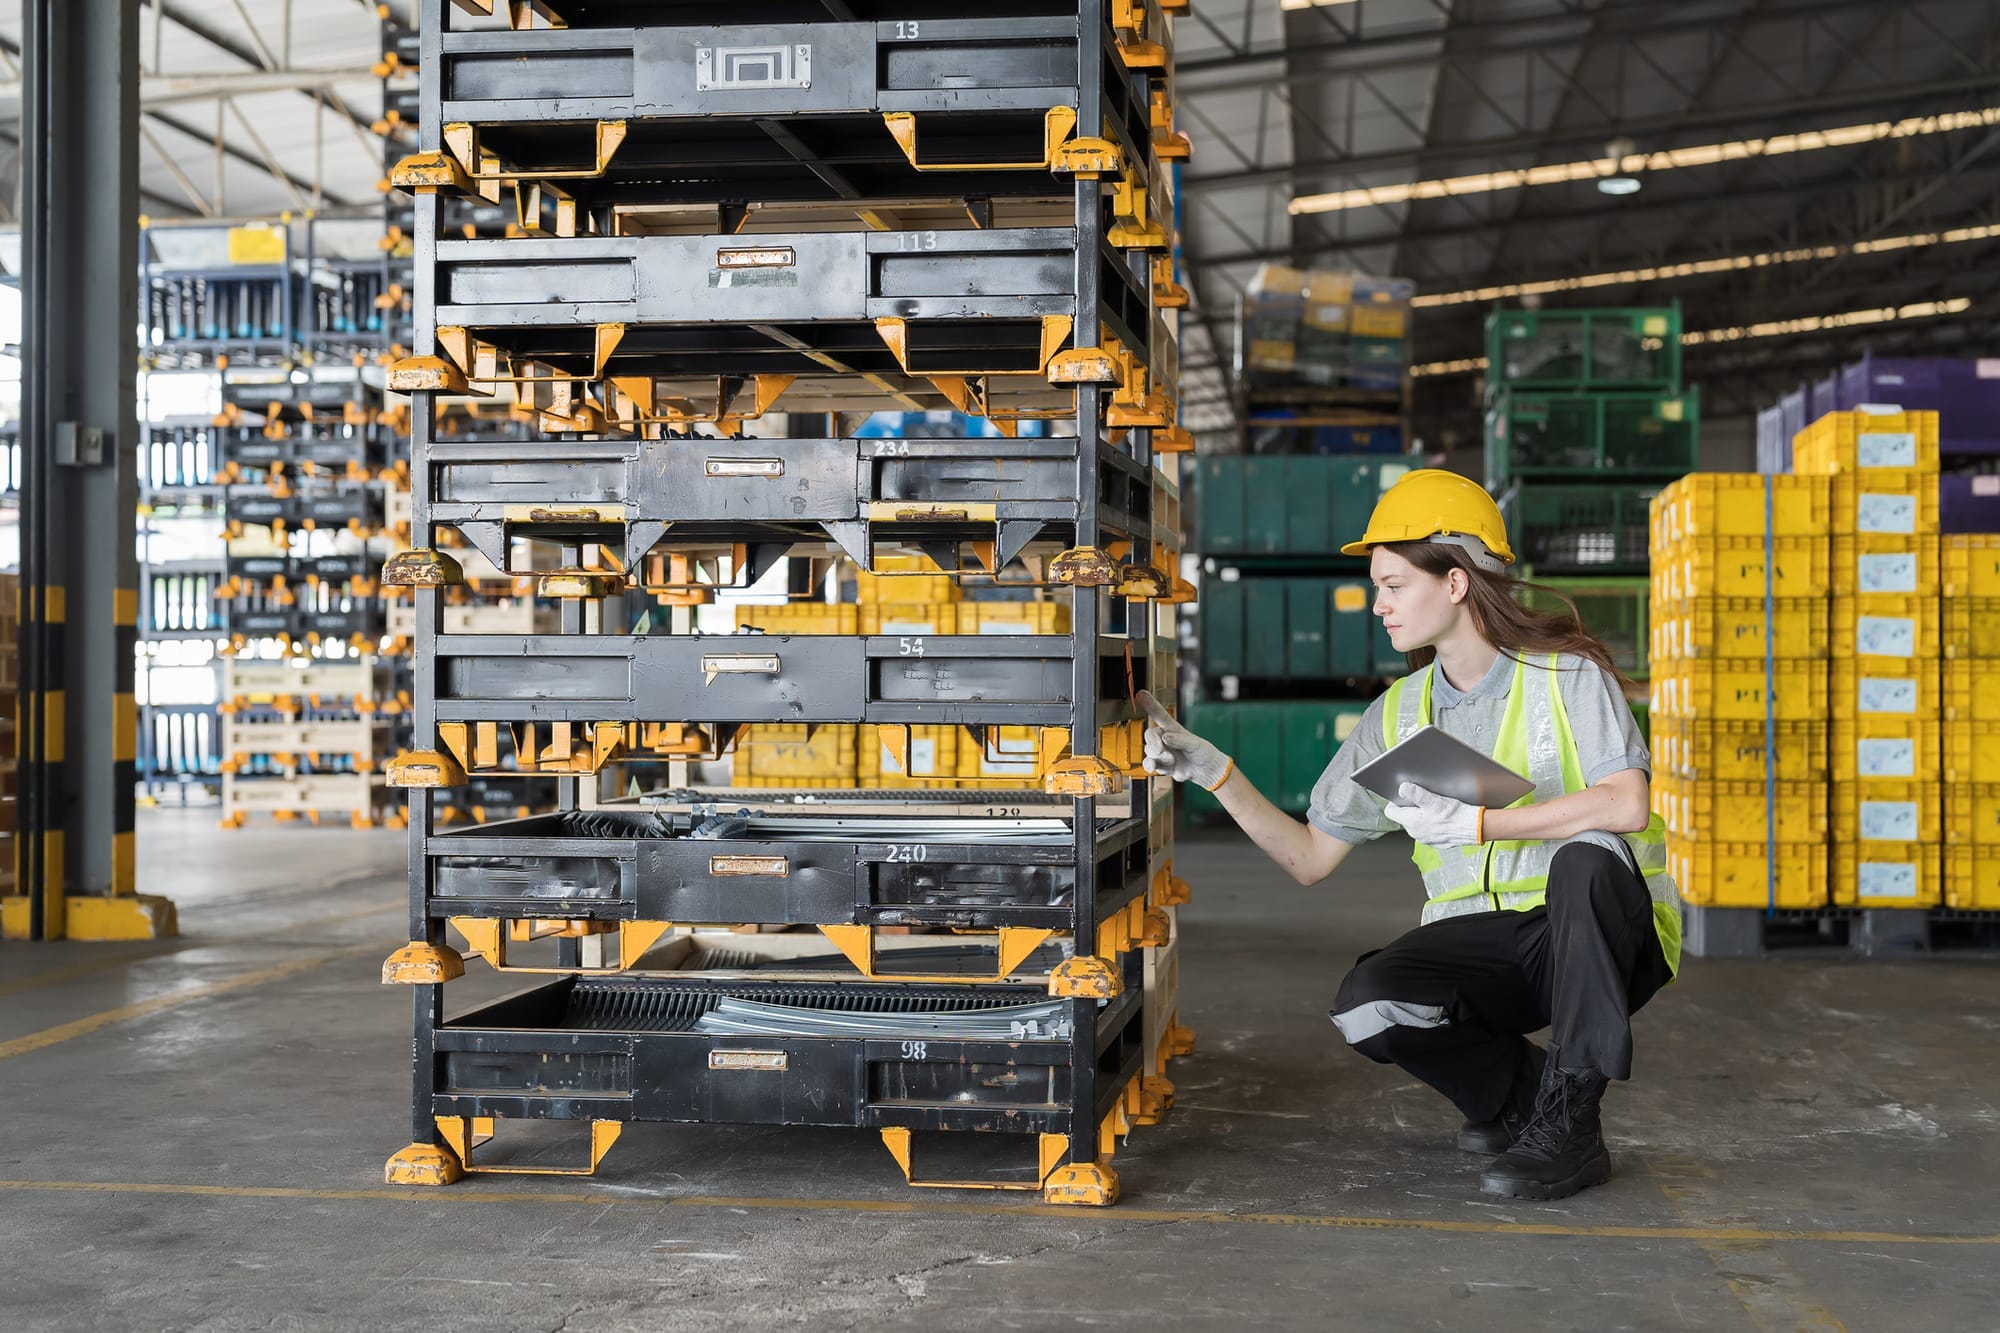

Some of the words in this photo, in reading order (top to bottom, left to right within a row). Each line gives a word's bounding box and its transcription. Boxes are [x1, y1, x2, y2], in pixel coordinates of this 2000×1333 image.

[896, 21, 919, 39] 13
[896, 231, 937, 251] 113
[899, 637, 925, 657] 54
[886, 844, 927, 863] 240
[901, 1040, 927, 1060] 98
